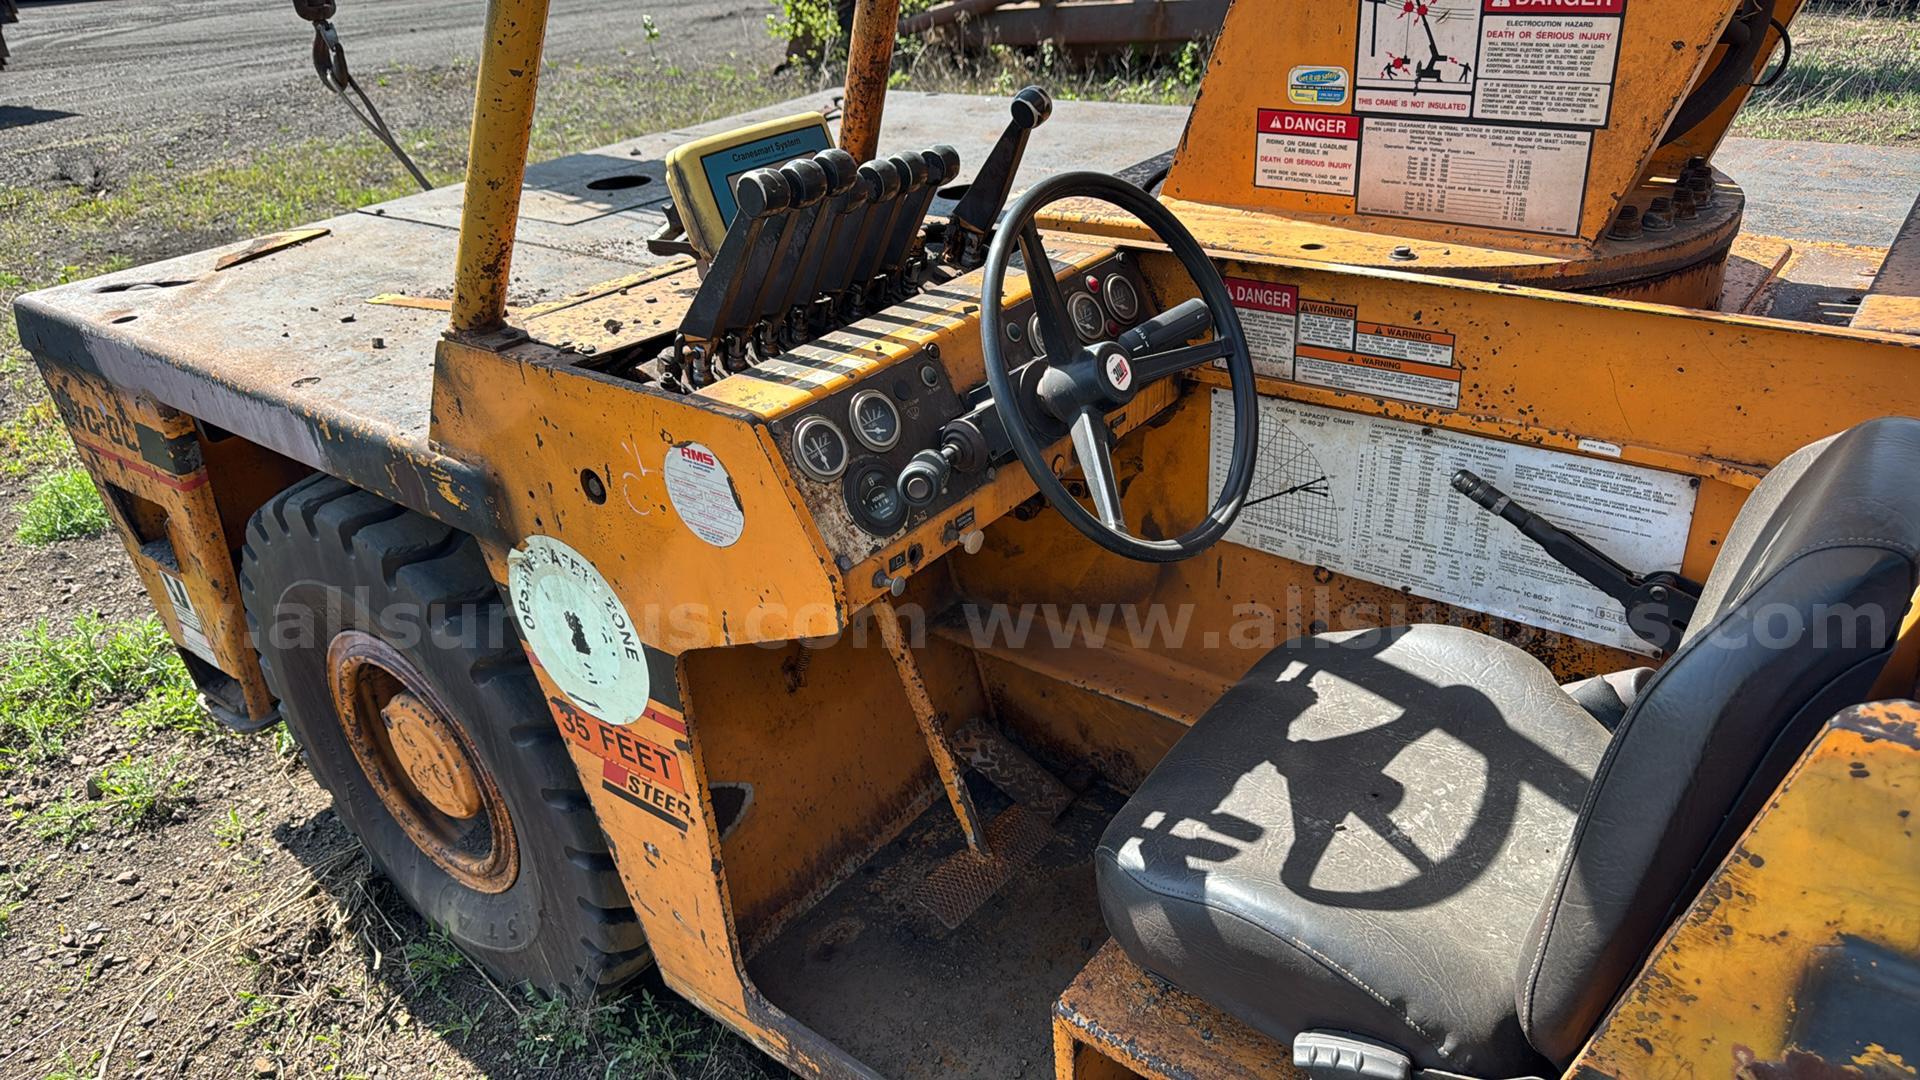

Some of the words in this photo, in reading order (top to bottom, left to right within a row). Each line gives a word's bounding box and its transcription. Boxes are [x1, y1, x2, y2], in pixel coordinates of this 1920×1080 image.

[1535, 31, 1574, 39] SERIOUS
[1578, 32, 1611, 40] INJURY
[1427, 101, 1466, 110] INSULATED
[1284, 116, 1346, 134] DANGER
[732, 145, 774, 162] Cranesmart
[775, 137, 801, 152] System
[1296, 158, 1324, 167] SERIOUS
[1327, 161, 1352, 169] INJURY
[1236, 286, 1290, 308] DANGER
[1308, 304, 1353, 318] WARNING
[1386, 328, 1432, 342] WARNING
[1361, 356, 1401, 370] WARNING
[1275, 406, 1296, 415] CRANE
[1299, 410, 1329, 421] CAPACITY
[1333, 416, 1354, 426] CHART
[681, 448, 715, 466] RMS
[604, 596, 640, 663] ZONE
[562, 708, 591, 742] 35
[598, 724, 672, 780] FEET
[628, 774, 690, 820] STEER
